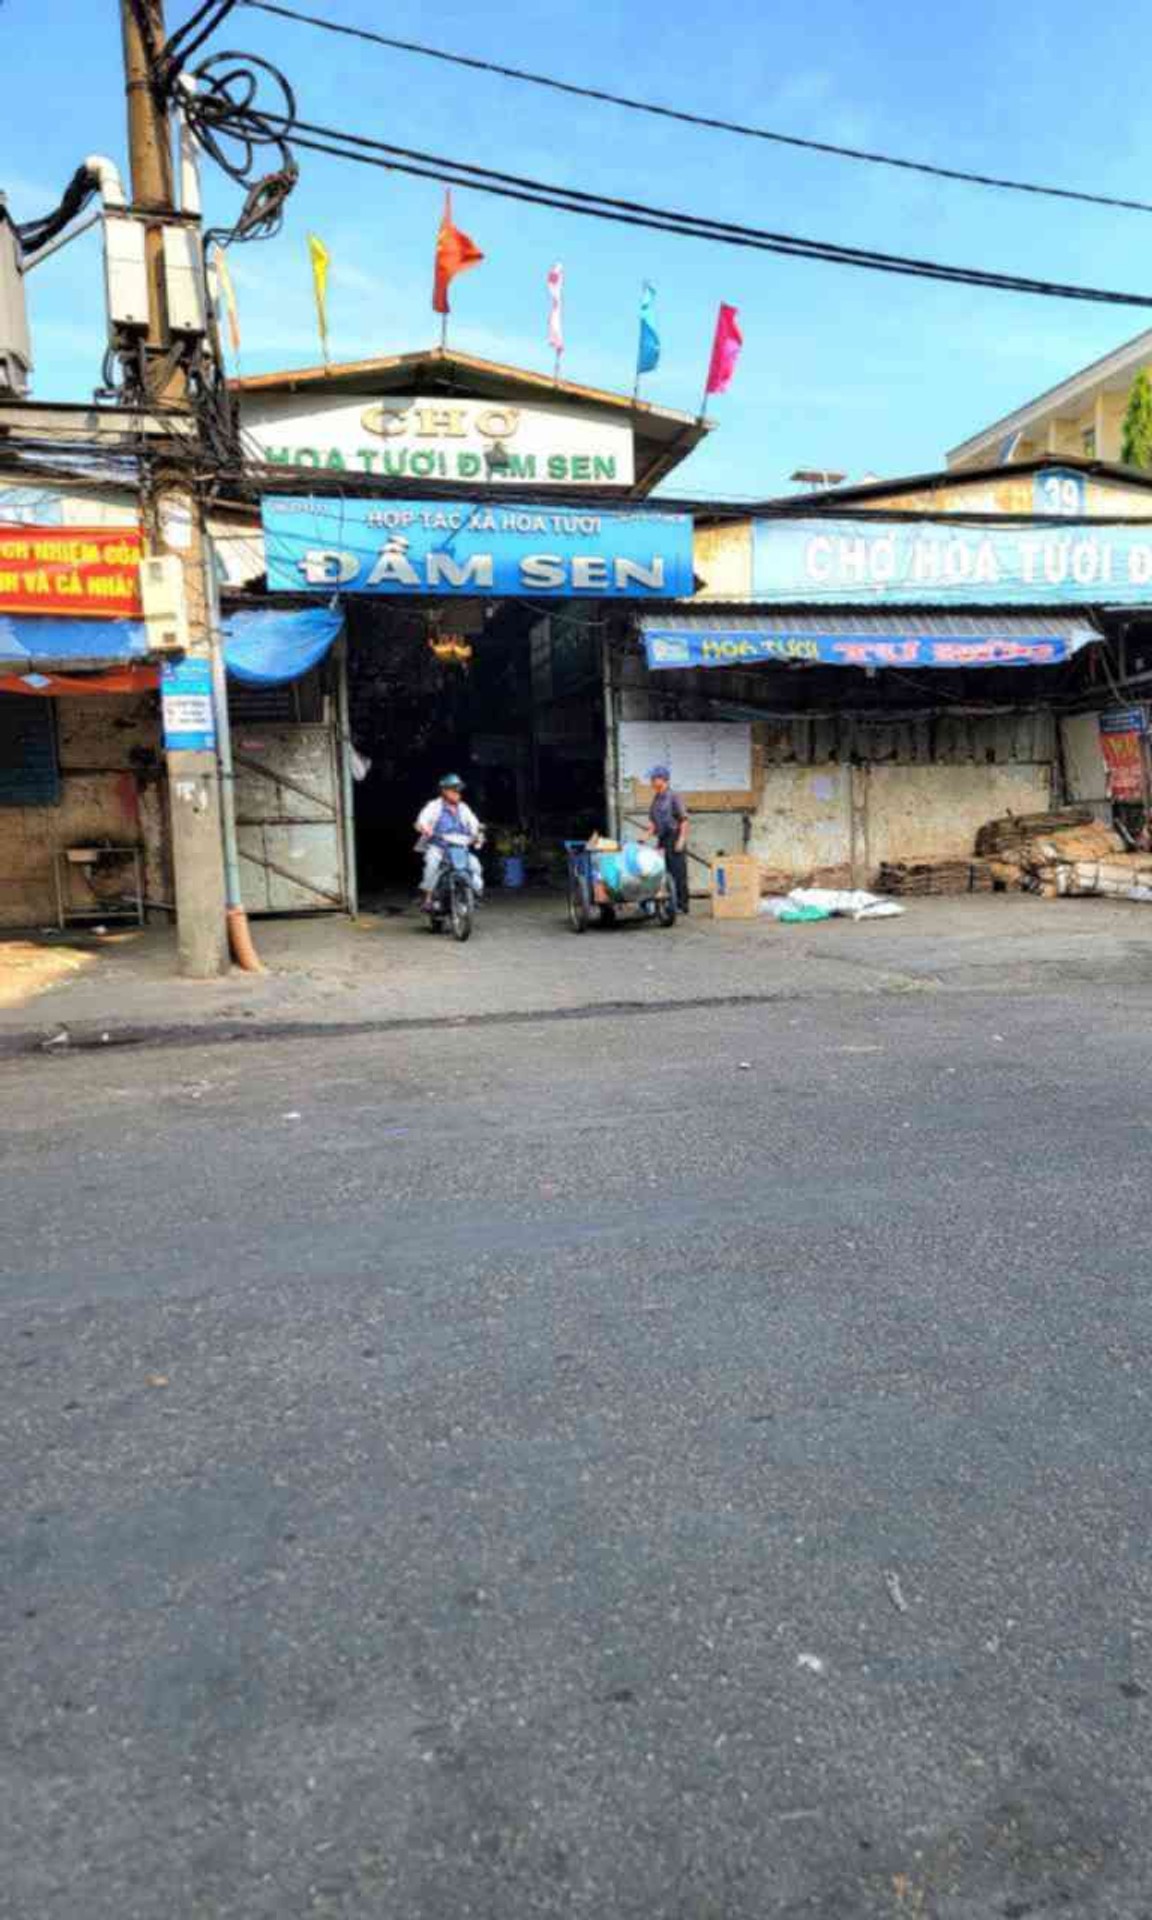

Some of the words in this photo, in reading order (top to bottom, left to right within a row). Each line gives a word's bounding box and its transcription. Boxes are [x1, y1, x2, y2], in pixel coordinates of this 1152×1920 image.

[264, 446, 348, 473] HOA
[546, 454, 617, 481] SEN
[1042, 476, 1080, 515] 39
[502, 513, 547, 533] HOA
[518, 553, 665, 589] SEN
[906, 537, 998, 583] HOA
